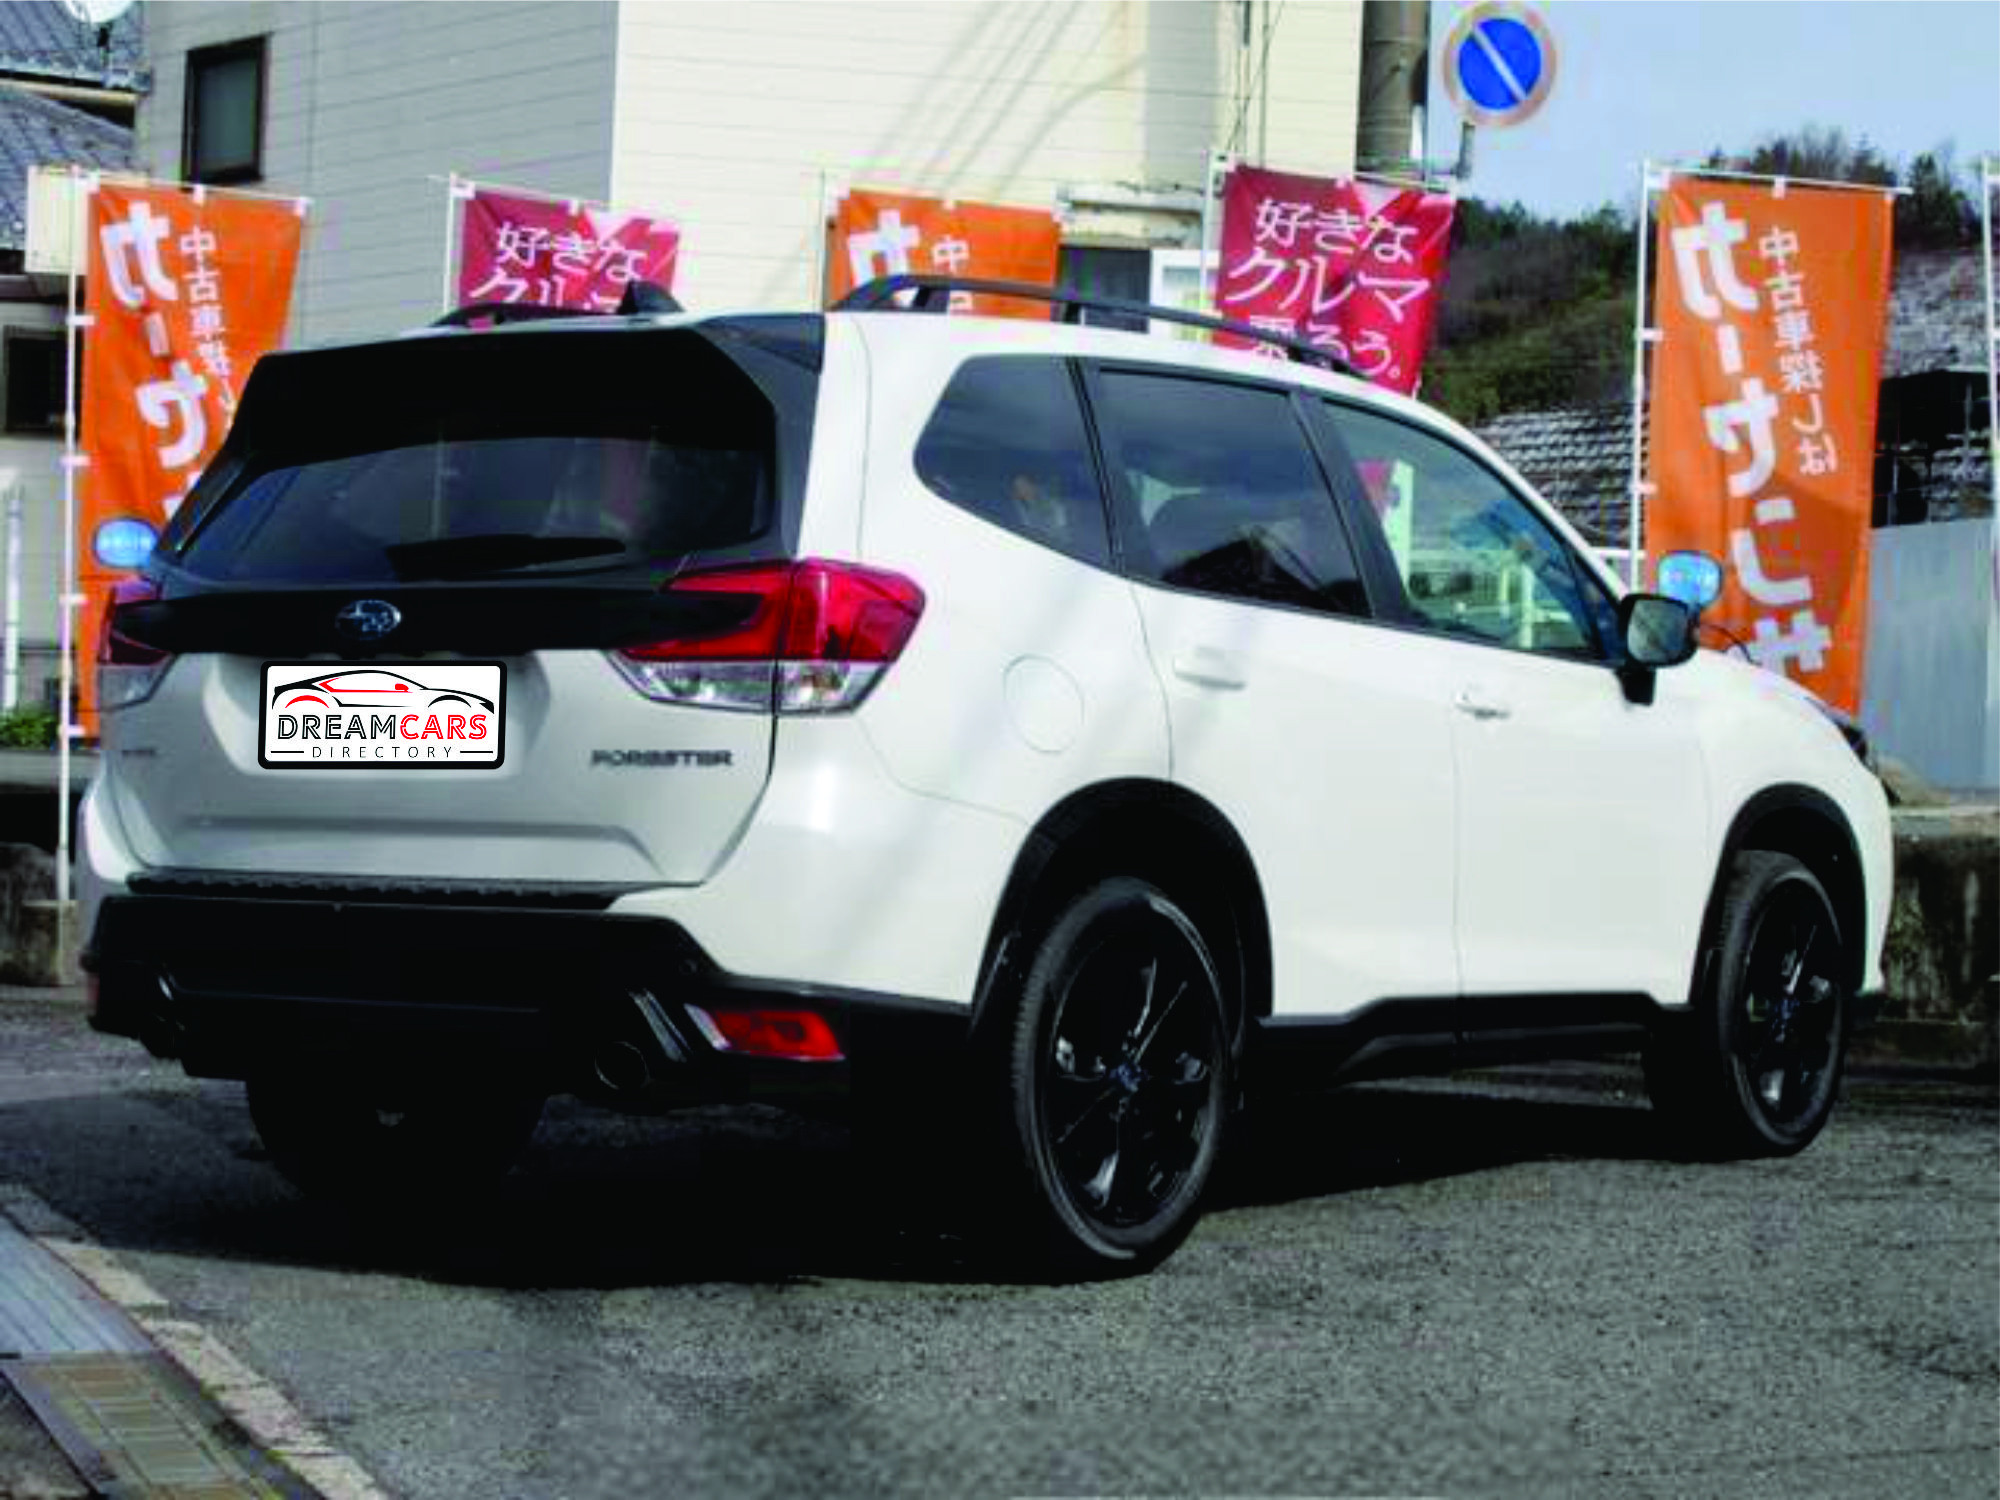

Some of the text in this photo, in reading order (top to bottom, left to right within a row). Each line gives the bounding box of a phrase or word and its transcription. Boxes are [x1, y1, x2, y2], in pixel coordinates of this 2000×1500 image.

[496, 220, 650, 281] 好きな
[1255, 196, 1419, 264] 好きな
[1224, 246, 1431, 323] クルマ
[591, 749, 733, 767] FORESTER
